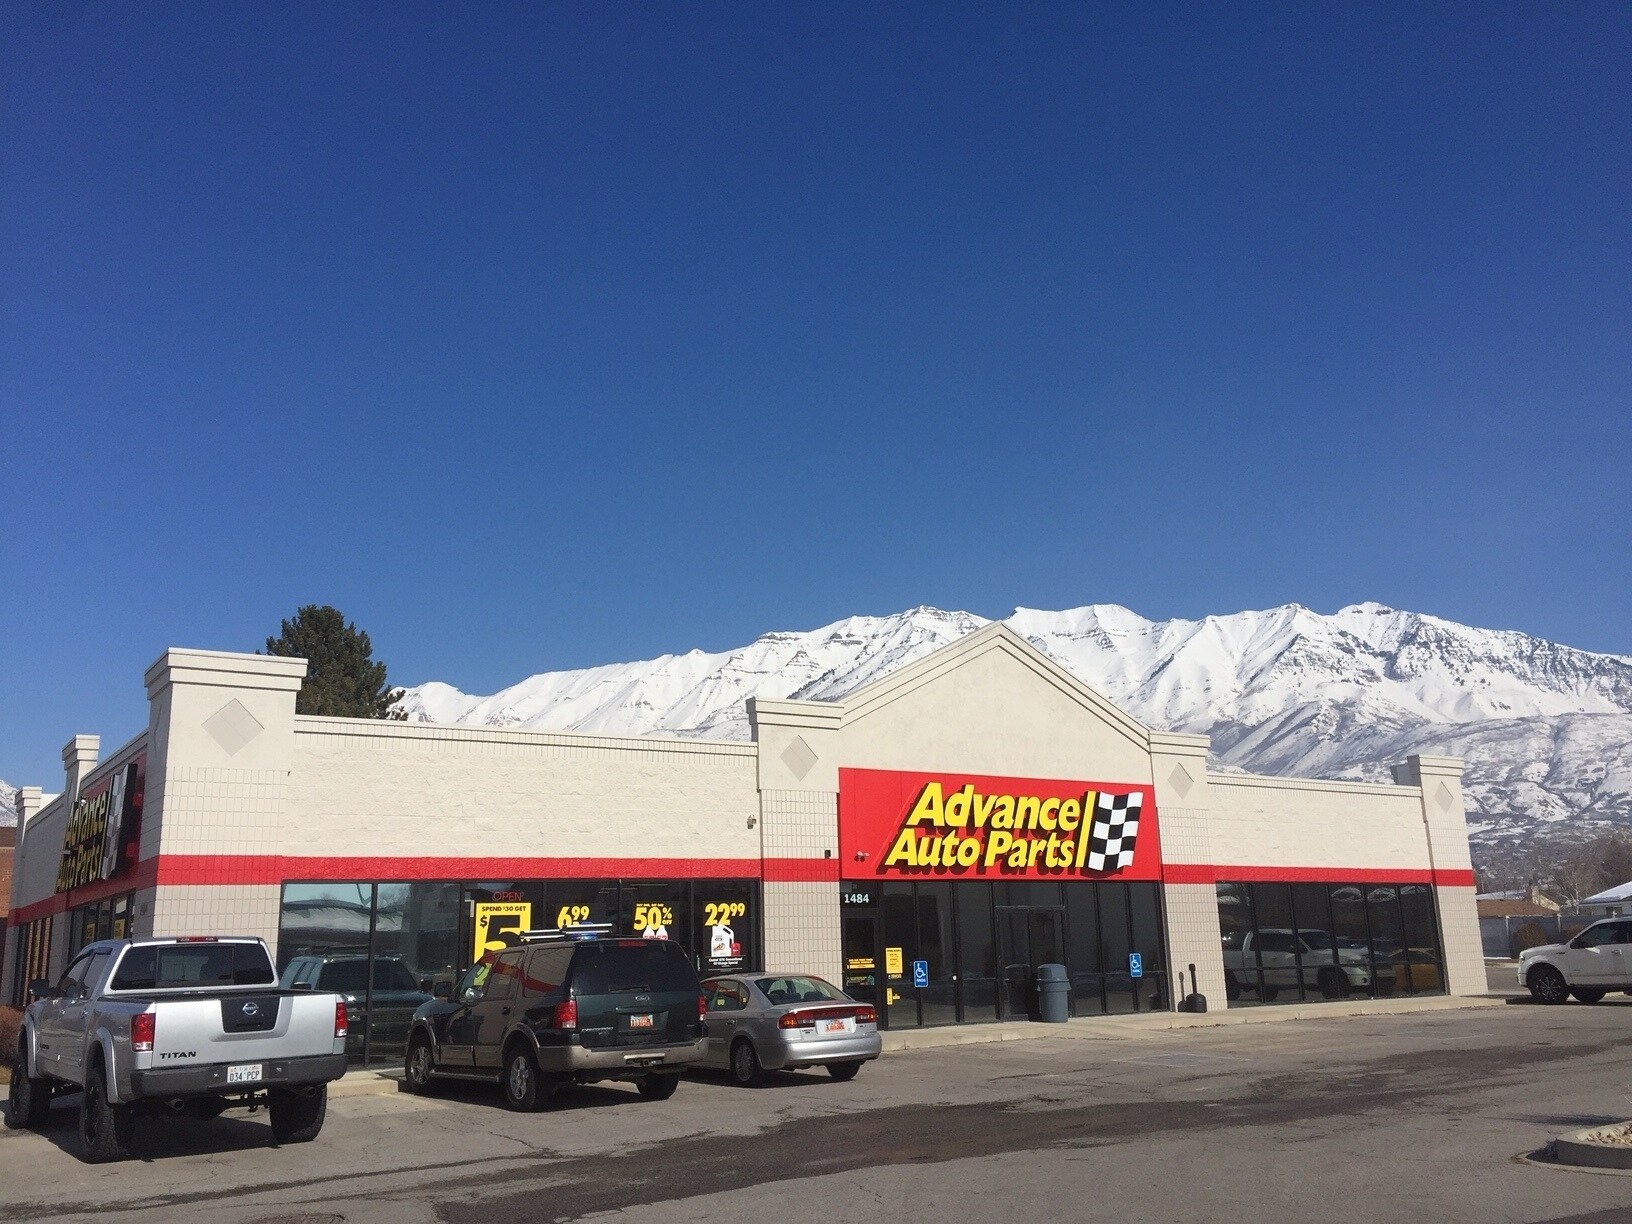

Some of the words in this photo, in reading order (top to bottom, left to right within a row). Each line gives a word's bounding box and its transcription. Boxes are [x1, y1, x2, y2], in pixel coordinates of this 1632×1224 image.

[906, 782, 1080, 831] Advance
[885, 828, 980, 867] Auto
[984, 830, 1075, 868] Parts
[492, 891, 521, 901] OPEN
[844, 894, 870, 904] 1484
[160, 1051, 197, 1060] TITAN
